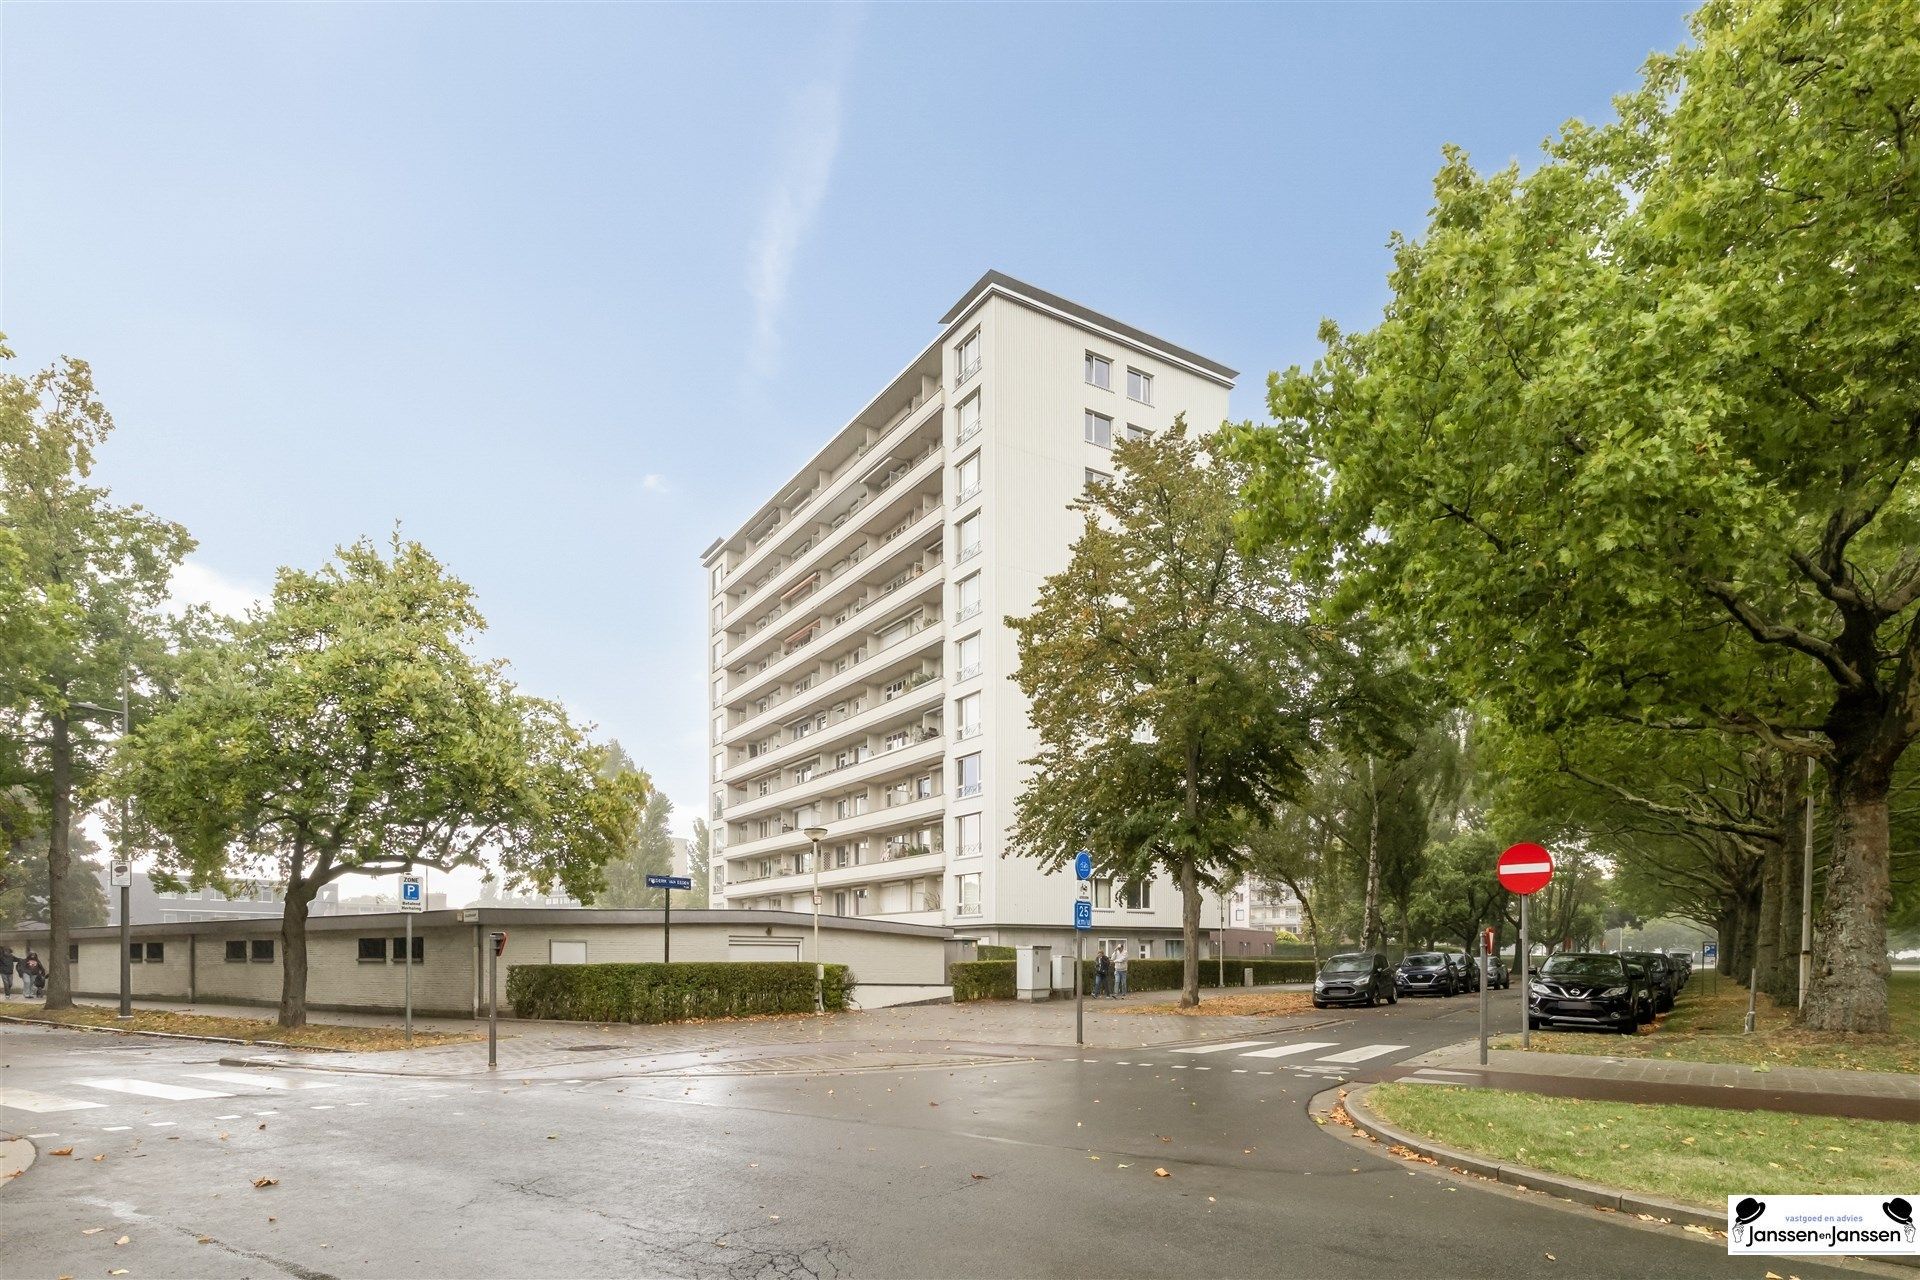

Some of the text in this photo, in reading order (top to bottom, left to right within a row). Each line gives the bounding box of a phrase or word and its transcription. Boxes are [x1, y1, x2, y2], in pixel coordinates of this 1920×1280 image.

[407, 884, 415, 896] P
[1079, 905, 1089, 917] 25
[1704, 945, 1711, 953] P
